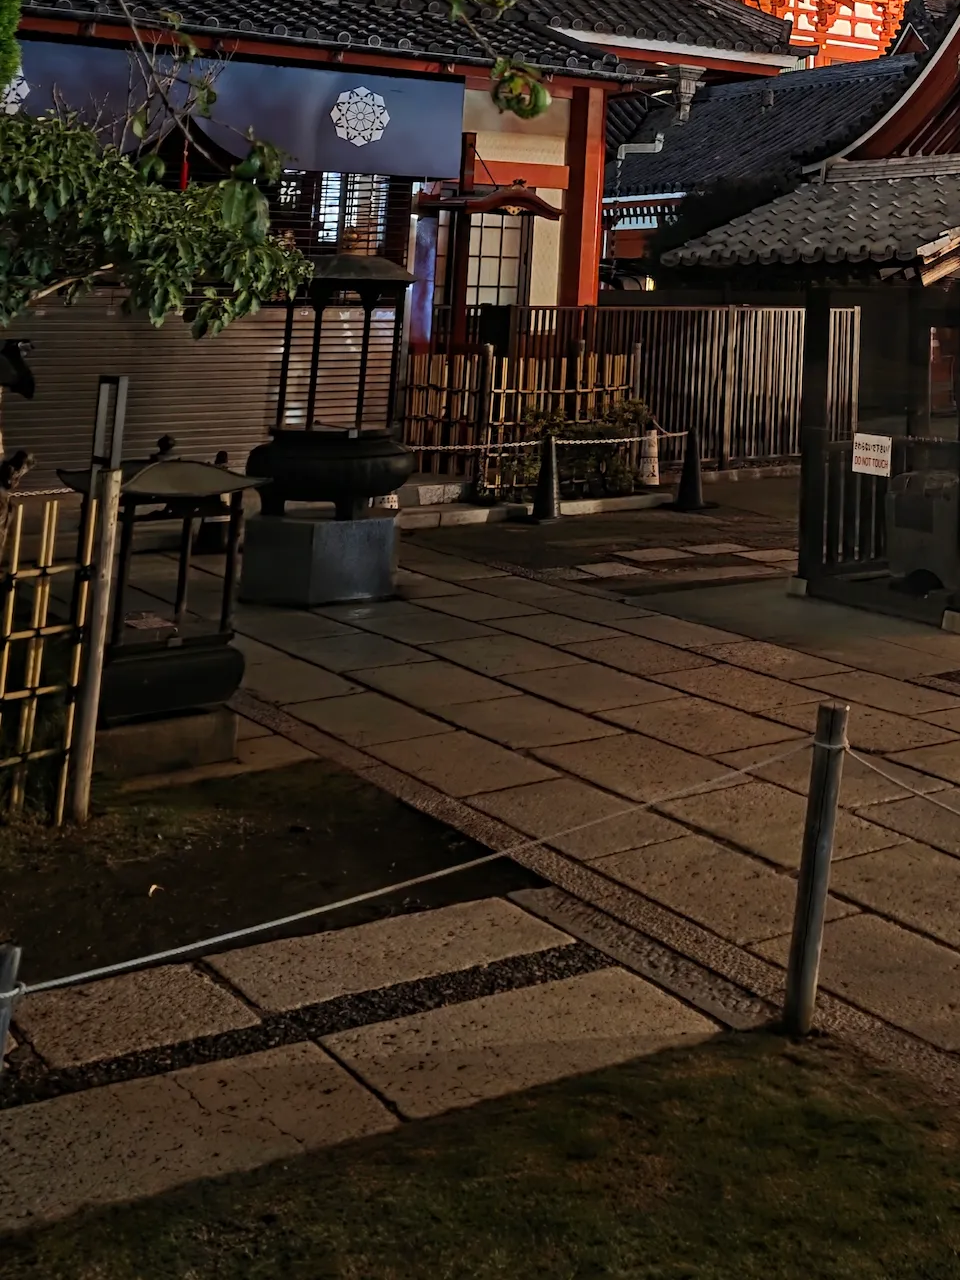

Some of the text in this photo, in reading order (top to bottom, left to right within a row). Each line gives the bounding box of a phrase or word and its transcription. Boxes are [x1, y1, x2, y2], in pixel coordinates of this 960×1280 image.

[854, 456, 888, 469] DO NOT TOUCH
